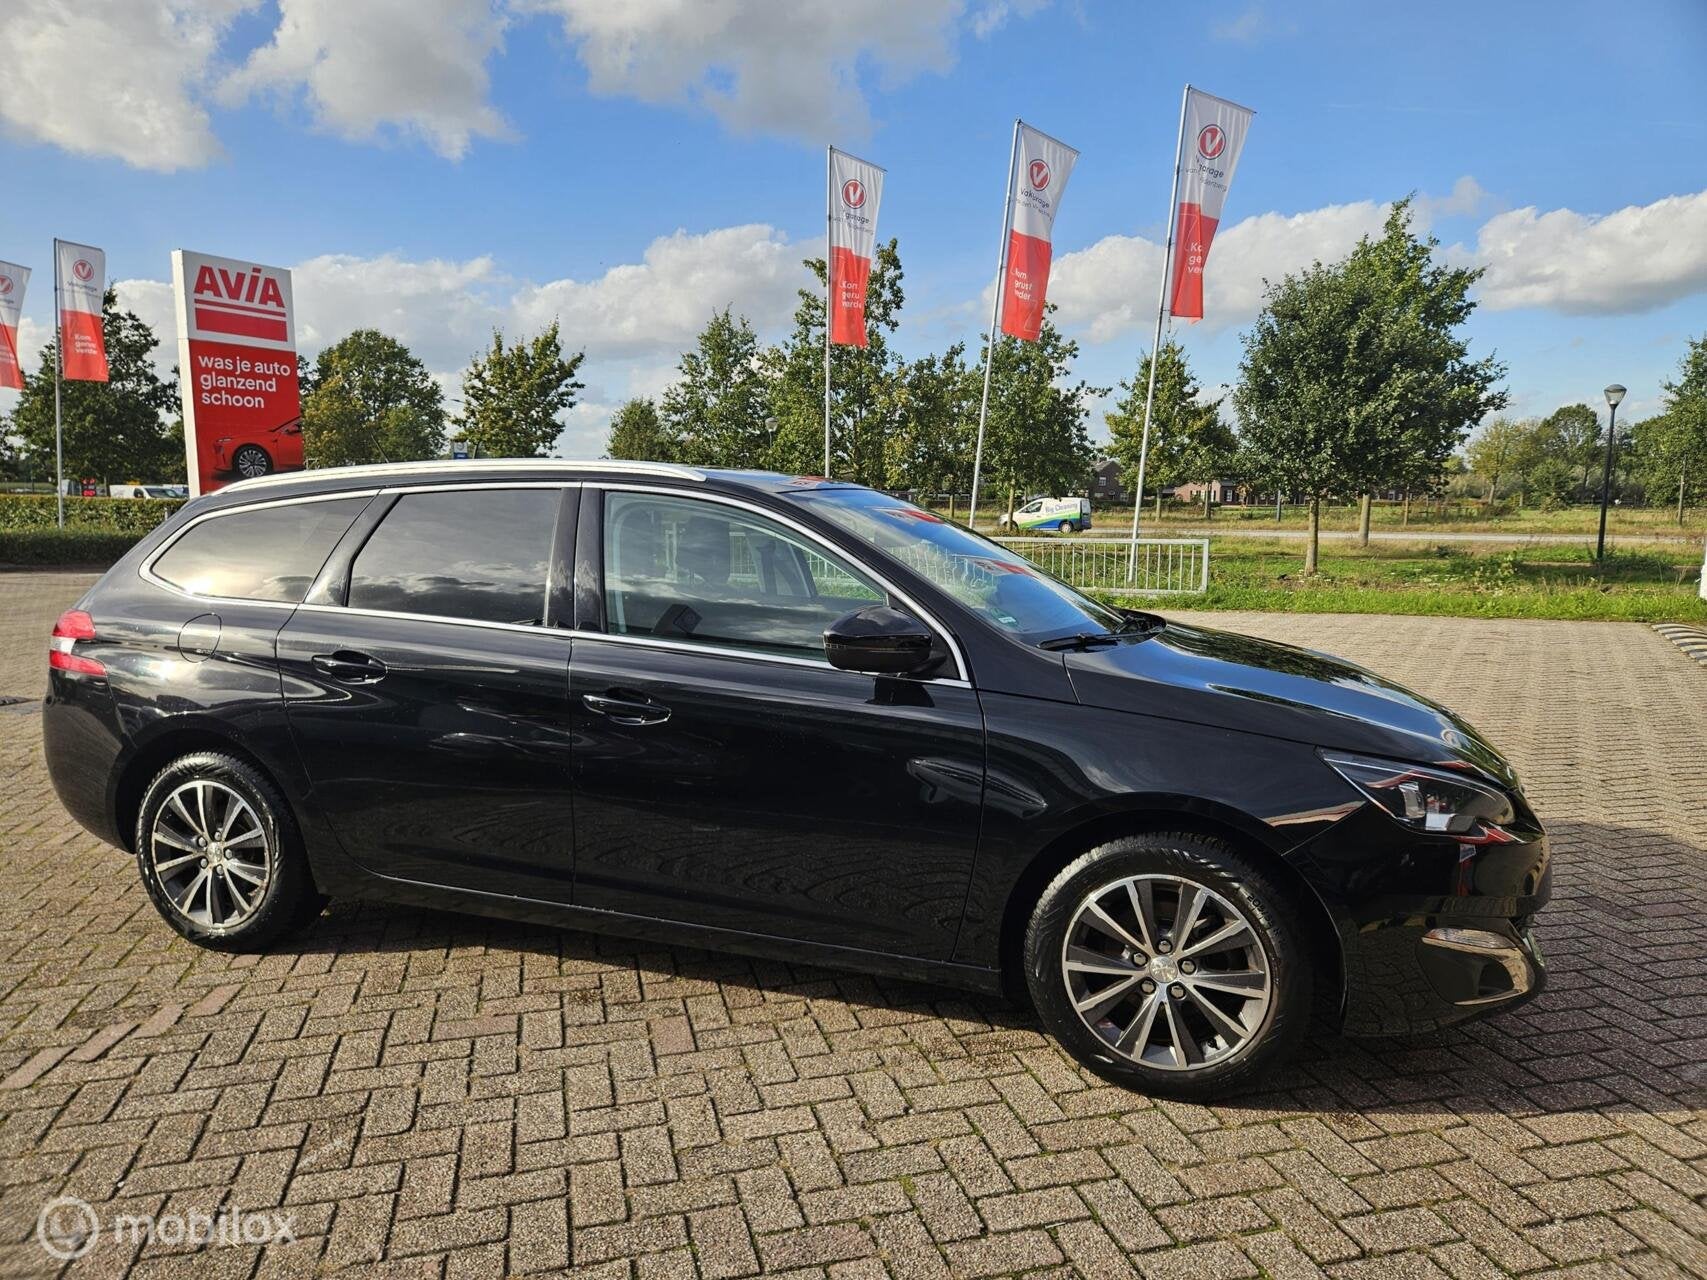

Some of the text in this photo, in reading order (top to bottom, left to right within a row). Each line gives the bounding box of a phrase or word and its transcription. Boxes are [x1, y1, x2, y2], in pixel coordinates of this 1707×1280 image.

[198, 355, 291, 377] was je auto
[200, 371, 277, 393] glanzend
[201, 390, 265, 409] schoon
